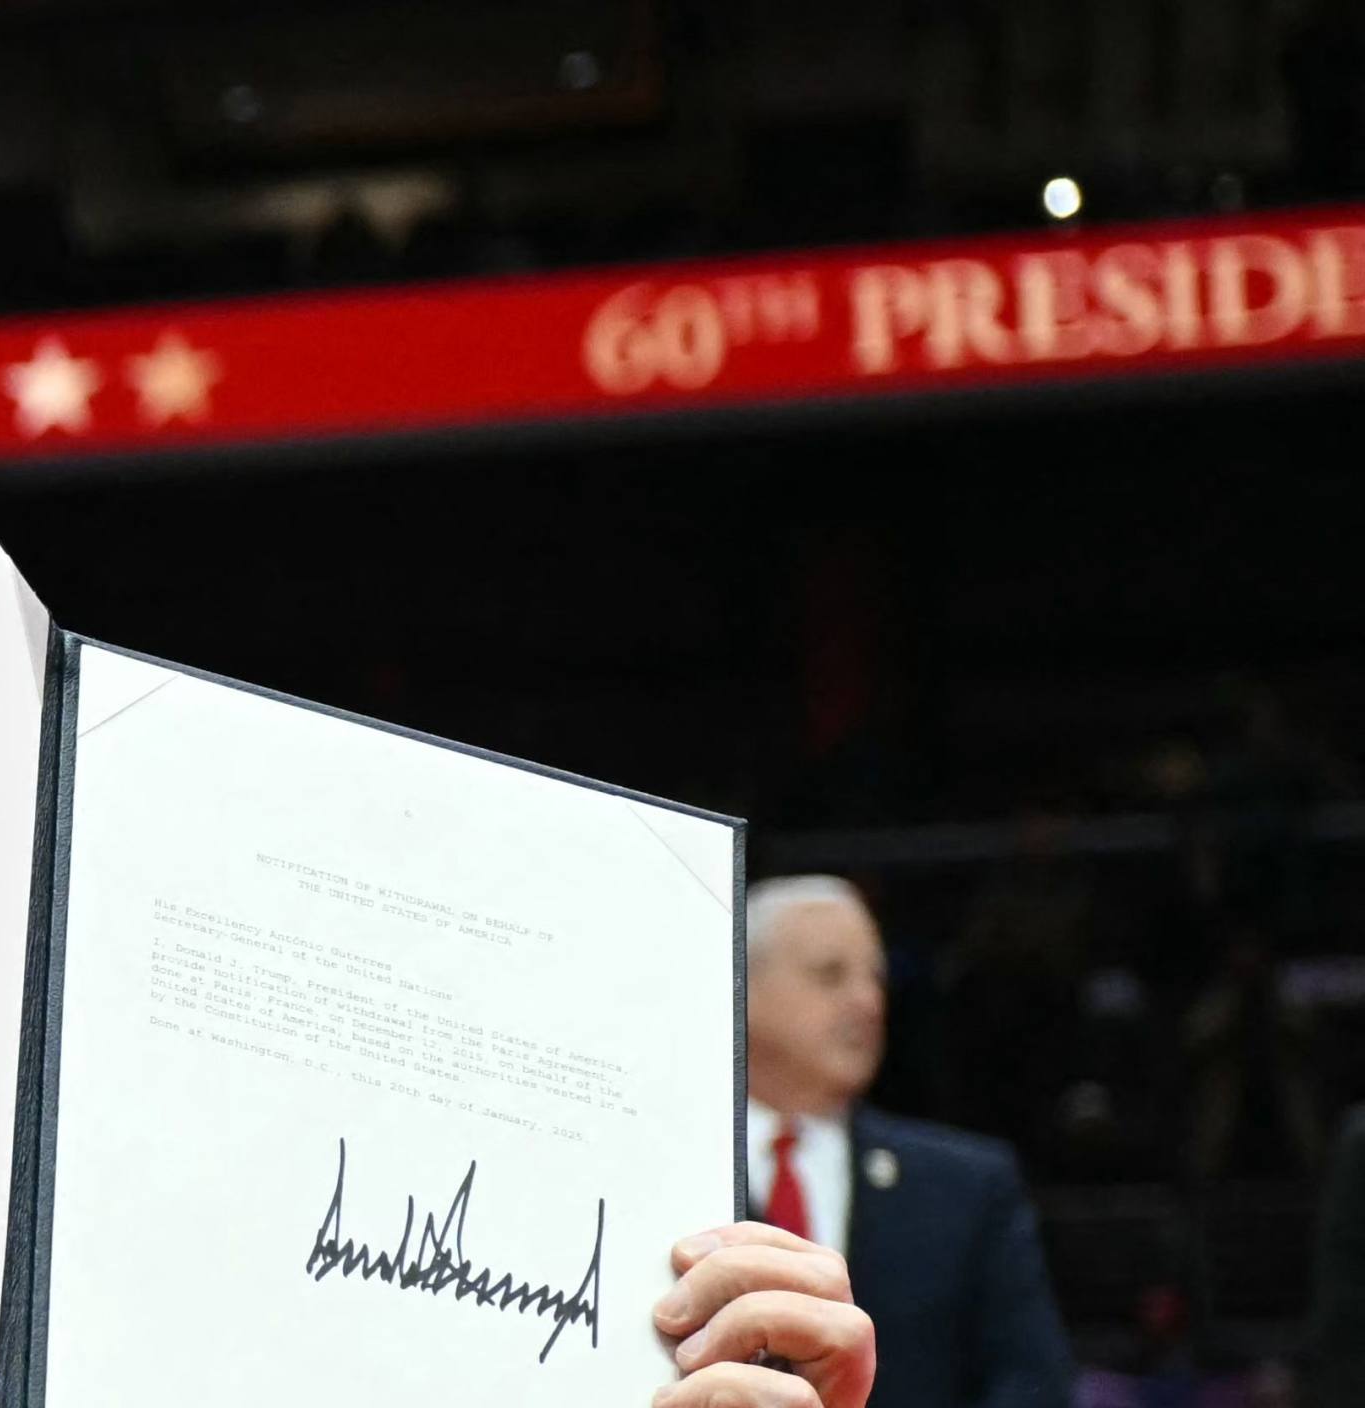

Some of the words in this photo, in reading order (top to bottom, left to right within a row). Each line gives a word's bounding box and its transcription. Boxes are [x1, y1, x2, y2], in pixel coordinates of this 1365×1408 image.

[154, 896, 176, 911] His
[185, 905, 261, 937] Excellency
[269, 929, 323, 953] António
[330, 946, 391, 972] Guterres
[256, 853, 348, 887] NOTIFICATION
[355, 880, 370, 893] OF
[378, 886, 454, 915] WITHDRAWAL
[462, 908, 477, 922] ON
[485, 915, 530, 936] BEHALF
[537, 929, 554, 942] OF
[298, 881, 320, 895] THE
[328, 889, 374, 909] UNITED
[382, 902, 427, 923] STATES
[435, 916, 450, 929] OF
[458, 922, 511, 945] AMERICA
[153, 909, 282, 956] Secretary-General
[292, 948, 307, 962] of
[315, 955, 337, 970] the
[346, 963, 391, 985] United
[398, 978, 454, 1003] Nations
[175, 941, 221, 963] Donald
[307, 978, 374, 1005] President
[383, 999, 397, 1012] of
[407, 1005, 429, 1020] the
[437, 1014, 483, 1035] United
[491, 1029, 537, 1050] States
[545, 1044, 560, 1057] of
[150, 988, 165, 1002] by
[174, 995, 196, 1010] the
[204, 1003, 297, 1038] Constitution
[304, 1031, 318, 1044] of
[329, 1038, 350, 1053] the
[359, 1047, 405, 1068] United
[151, 948, 205, 973] provide
[214, 966, 306, 1000] notification
[314, 993, 327, 1006] of
[336, 999, 411, 1029] withdrawal
[422, 1023, 452, 1040] from
[461, 1034, 482, 1049] the
[492, 1042, 529, 1062] Paris
[151, 962, 181, 979] done
[190, 973, 204, 985] at
[329, 1012, 344, 1024] on
[352, 1017, 413, 1043] December
[498, 1058, 513, 1070] on
[522, 1064, 566, 1085] behalf
[576, 1078, 589, 1091] of
[599, 1085, 622, 1100] the
[151, 975, 197, 997] United
[204, 990, 250, 1011] States
[258, 1004, 273, 1017] of
[352, 1030, 390, 1050] based
[398, 1044, 413, 1056] on
[422, 1049, 443, 1064] the
[452, 1058, 537, 1090] authorities
[545, 1083, 591, 1105] vested
[600, 1098, 614, 1111] in
[149, 1014, 179, 1031] Done
[187, 1024, 203, 1038] at
[351, 1070, 381, 1087] this
[390, 1081, 420, 1098] 20th
[428, 1091, 453, 1108] day
[459, 1100, 476, 1114] of
